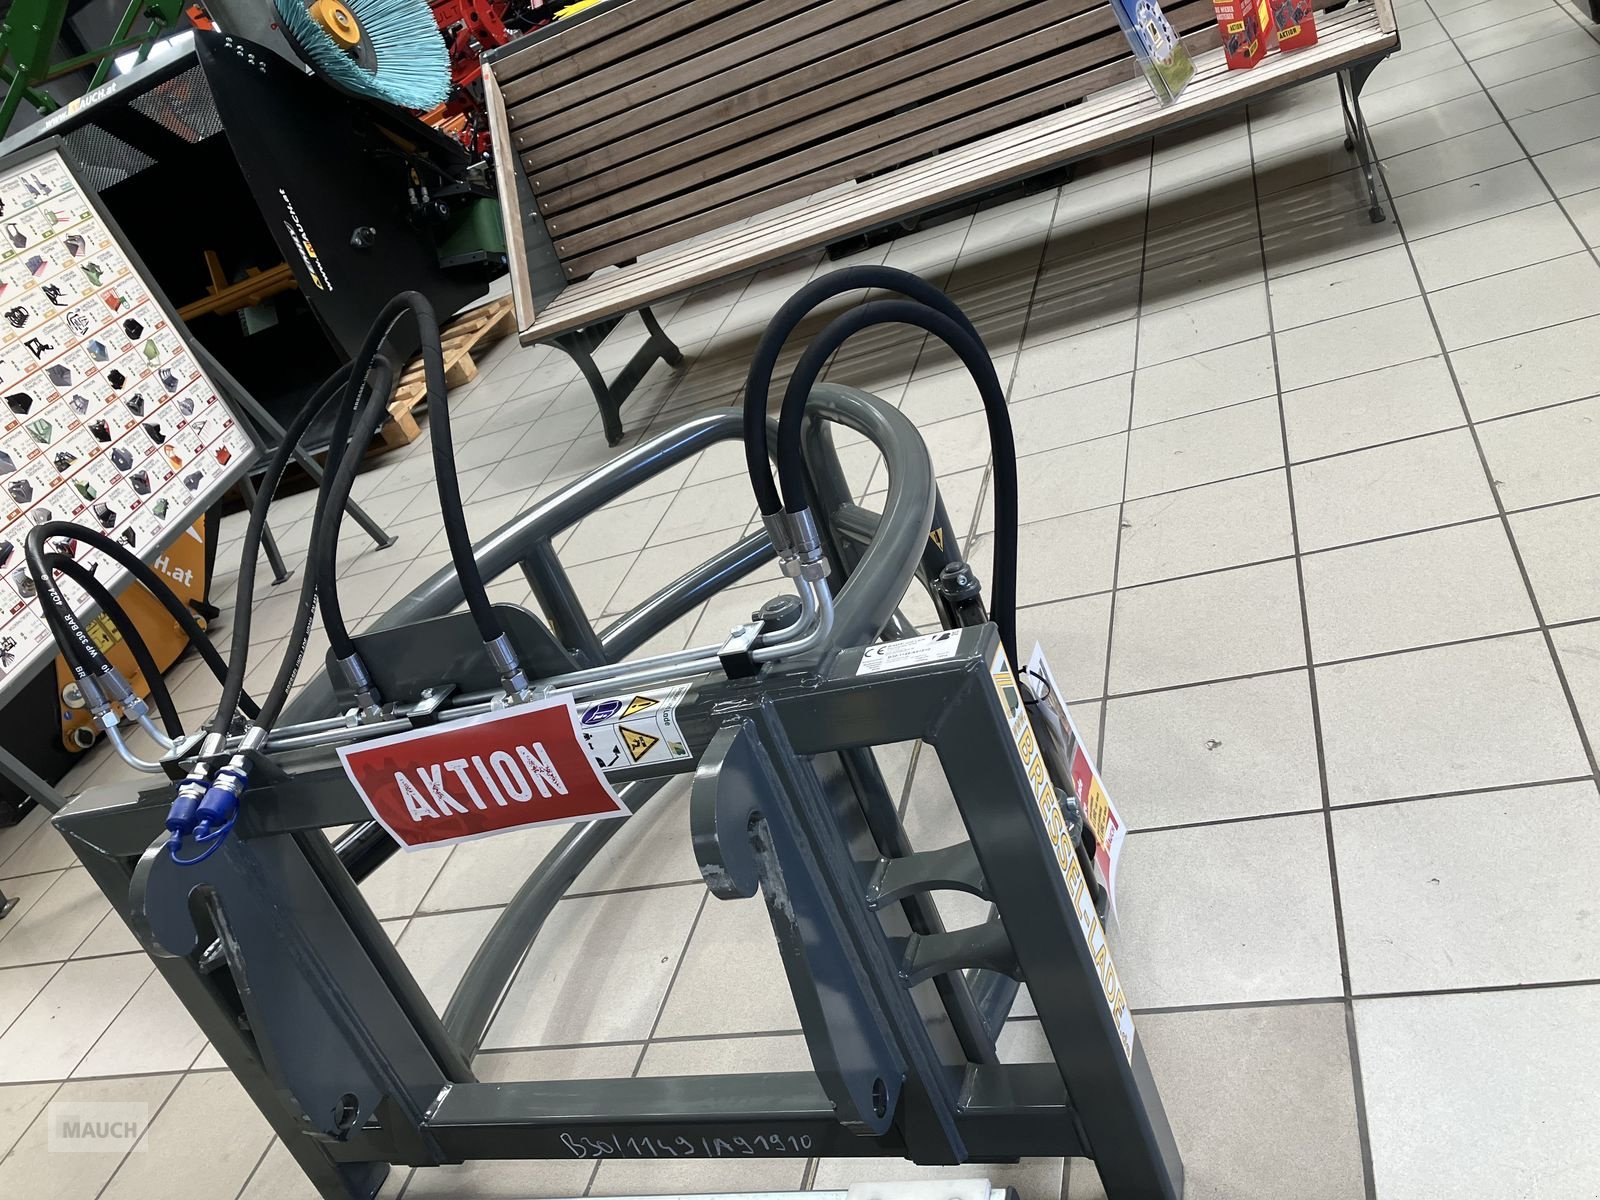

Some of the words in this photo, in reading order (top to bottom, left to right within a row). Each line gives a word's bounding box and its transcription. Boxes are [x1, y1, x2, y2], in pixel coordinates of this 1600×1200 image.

[1279, 27, 1298, 38] AKTION
[64, 614, 79, 631] BAR
[75, 631, 89, 644] 330
[86, 645, 98, 658] WP
[394, 741, 569, 822] AKTION
